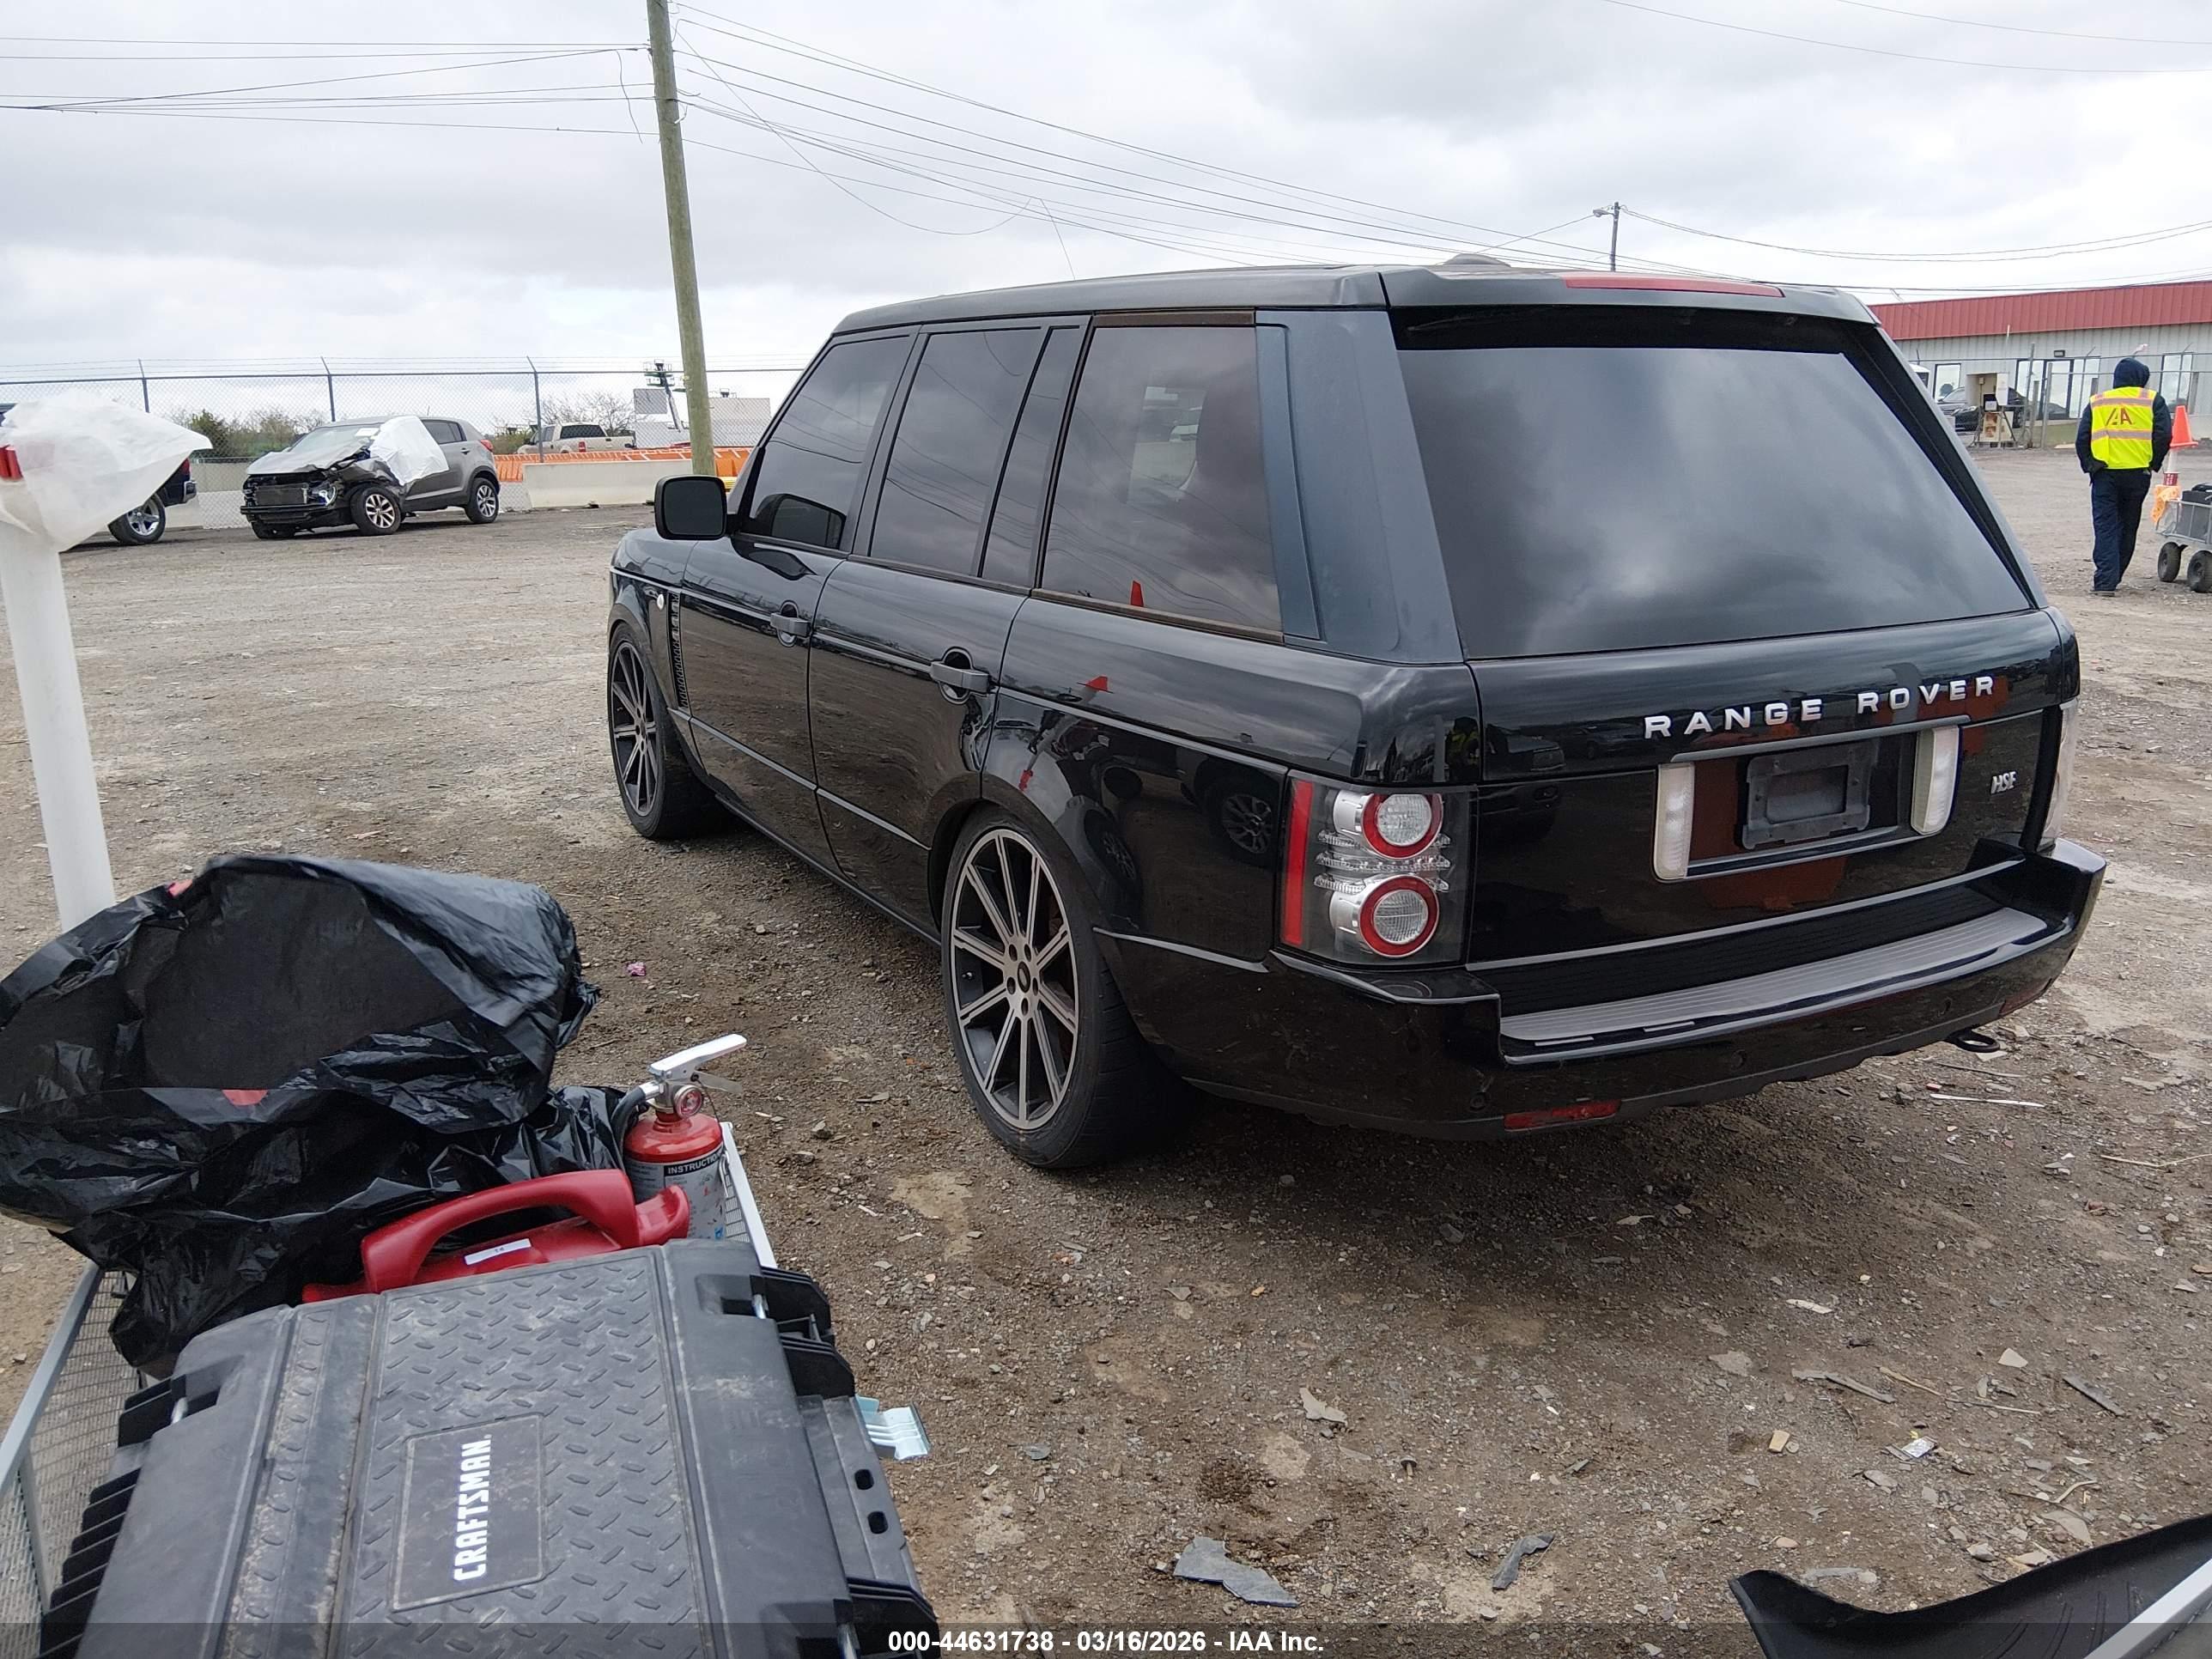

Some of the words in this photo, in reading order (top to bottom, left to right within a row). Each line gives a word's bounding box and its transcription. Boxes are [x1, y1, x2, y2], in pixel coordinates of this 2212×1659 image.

[1644, 698, 1822, 739] RANGE
[1856, 675, 1994, 714] ROVER
[1990, 770, 2017, 795] HSE
[453, 1439, 492, 1582] CRAFTSMAN
